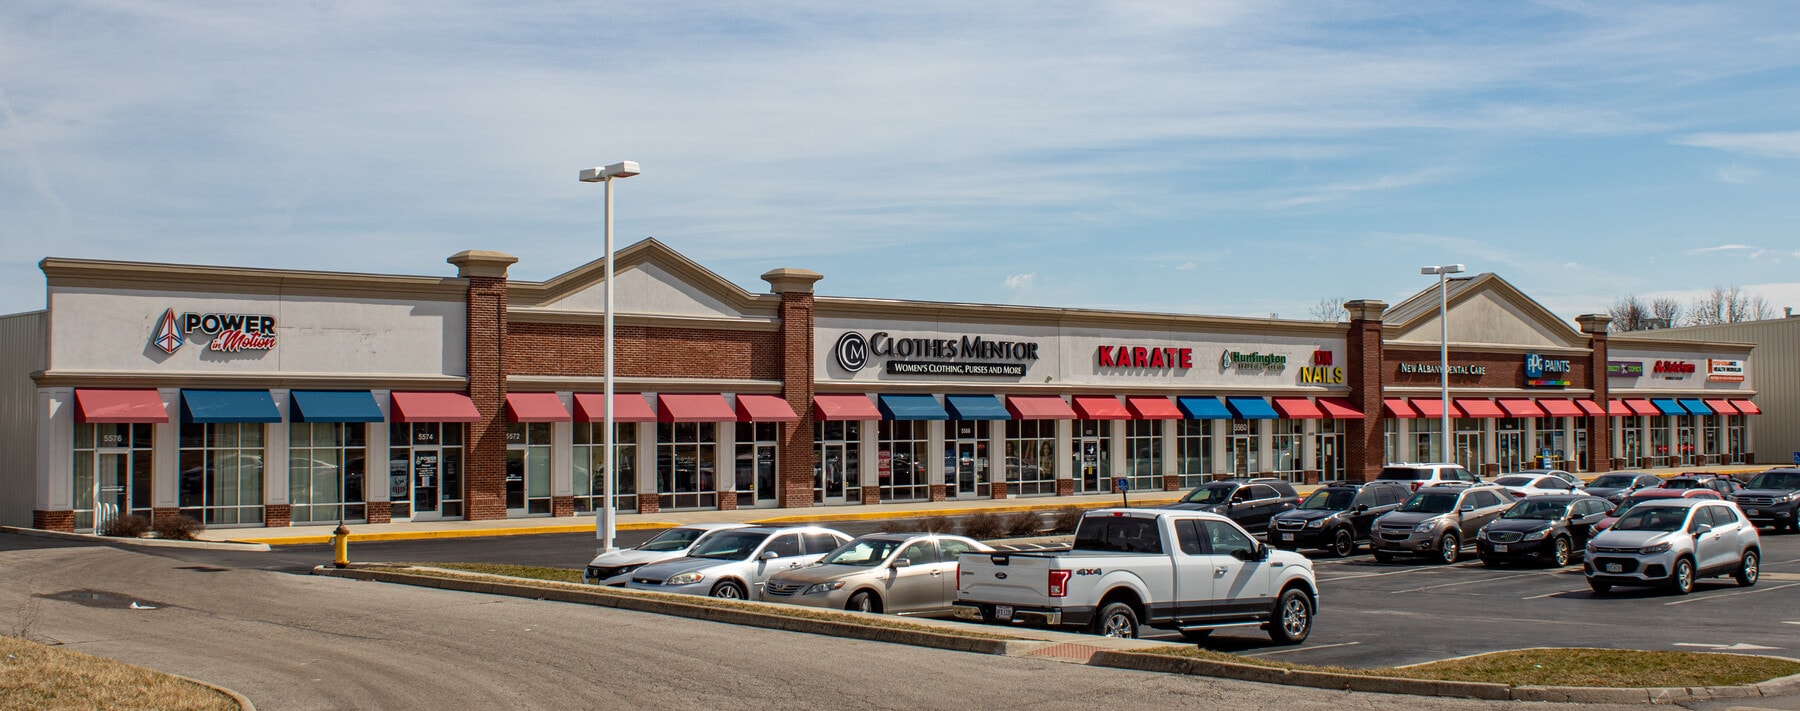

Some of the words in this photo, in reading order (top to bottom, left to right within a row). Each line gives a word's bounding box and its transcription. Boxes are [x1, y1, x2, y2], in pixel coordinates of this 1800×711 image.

[186, 313, 276, 333] POWER
[211, 339, 222, 350] in
[219, 330, 276, 351] Motion
[871, 332, 957, 358] CLOTHES
[960, 335, 1039, 360] MENTOR
[1098, 345, 1193, 368] KARATE
[1230, 351, 1287, 366] Huntington
[1527, 354, 1543, 374] PPG
[1544, 359, 1571, 373] PAINTS
[894, 363, 928, 372] WOMEN'S
[965, 364, 988, 374] PURSES
[988, 365, 1002, 374] AND
[1003, 365, 1022, 375] MORE
[1300, 366, 1343, 384] NAILS
[1401, 362, 1416, 373] NEW
[1469, 364, 1486, 375] CARE
[103, 434, 123, 442] 5576
